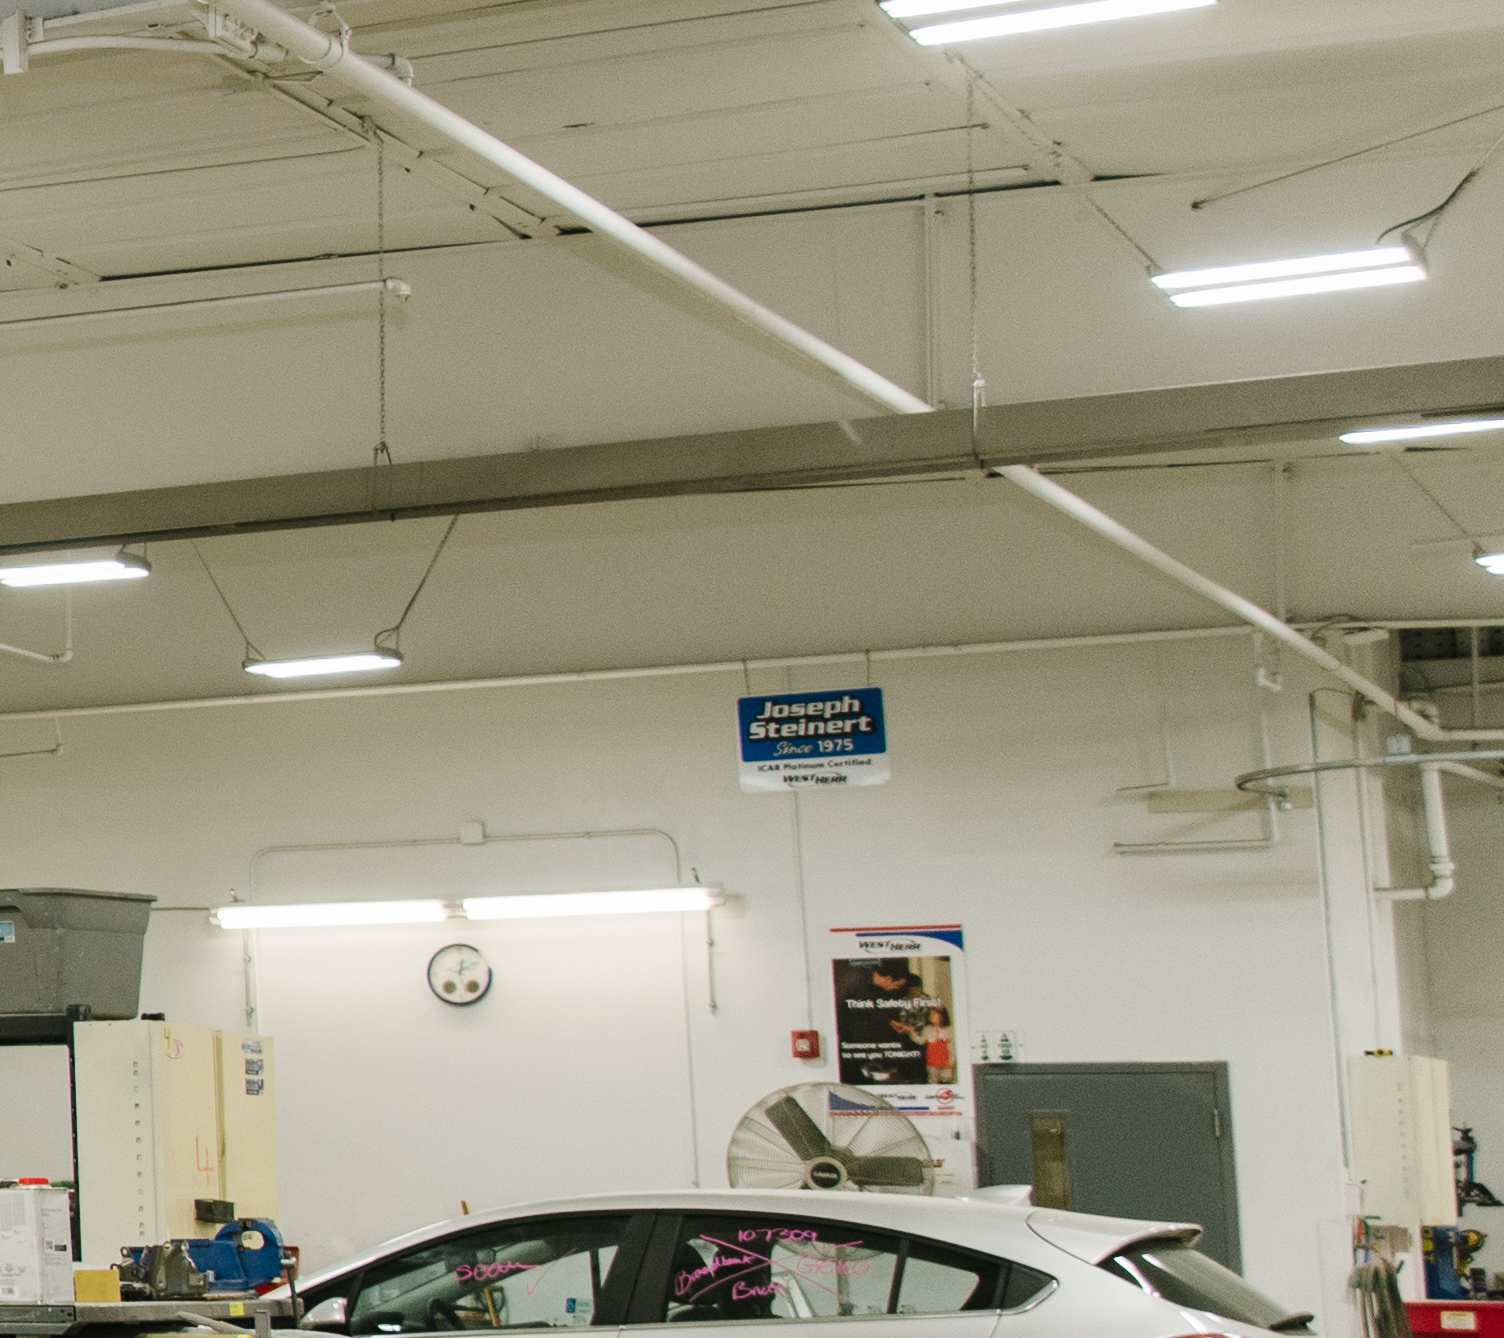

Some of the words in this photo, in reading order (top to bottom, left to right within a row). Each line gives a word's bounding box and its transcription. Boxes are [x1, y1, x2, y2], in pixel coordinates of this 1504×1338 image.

[756, 695, 861, 719] Joseph
[749, 715, 872, 739] Steinert
[773, 741, 813, 757] Since
[817, 738, 854, 753] 1975
[783, 762, 824, 770] Platinum
[827, 758, 872, 767] Certified
[845, 999, 875, 1009] Think
[876, 998, 912, 1009] Safety
[913, 997, 942, 1008] First!
[883, 1041, 902, 1049] wants
[868, 1052, 883, 1061] you
[195, 1134, 214, 1189] 4
